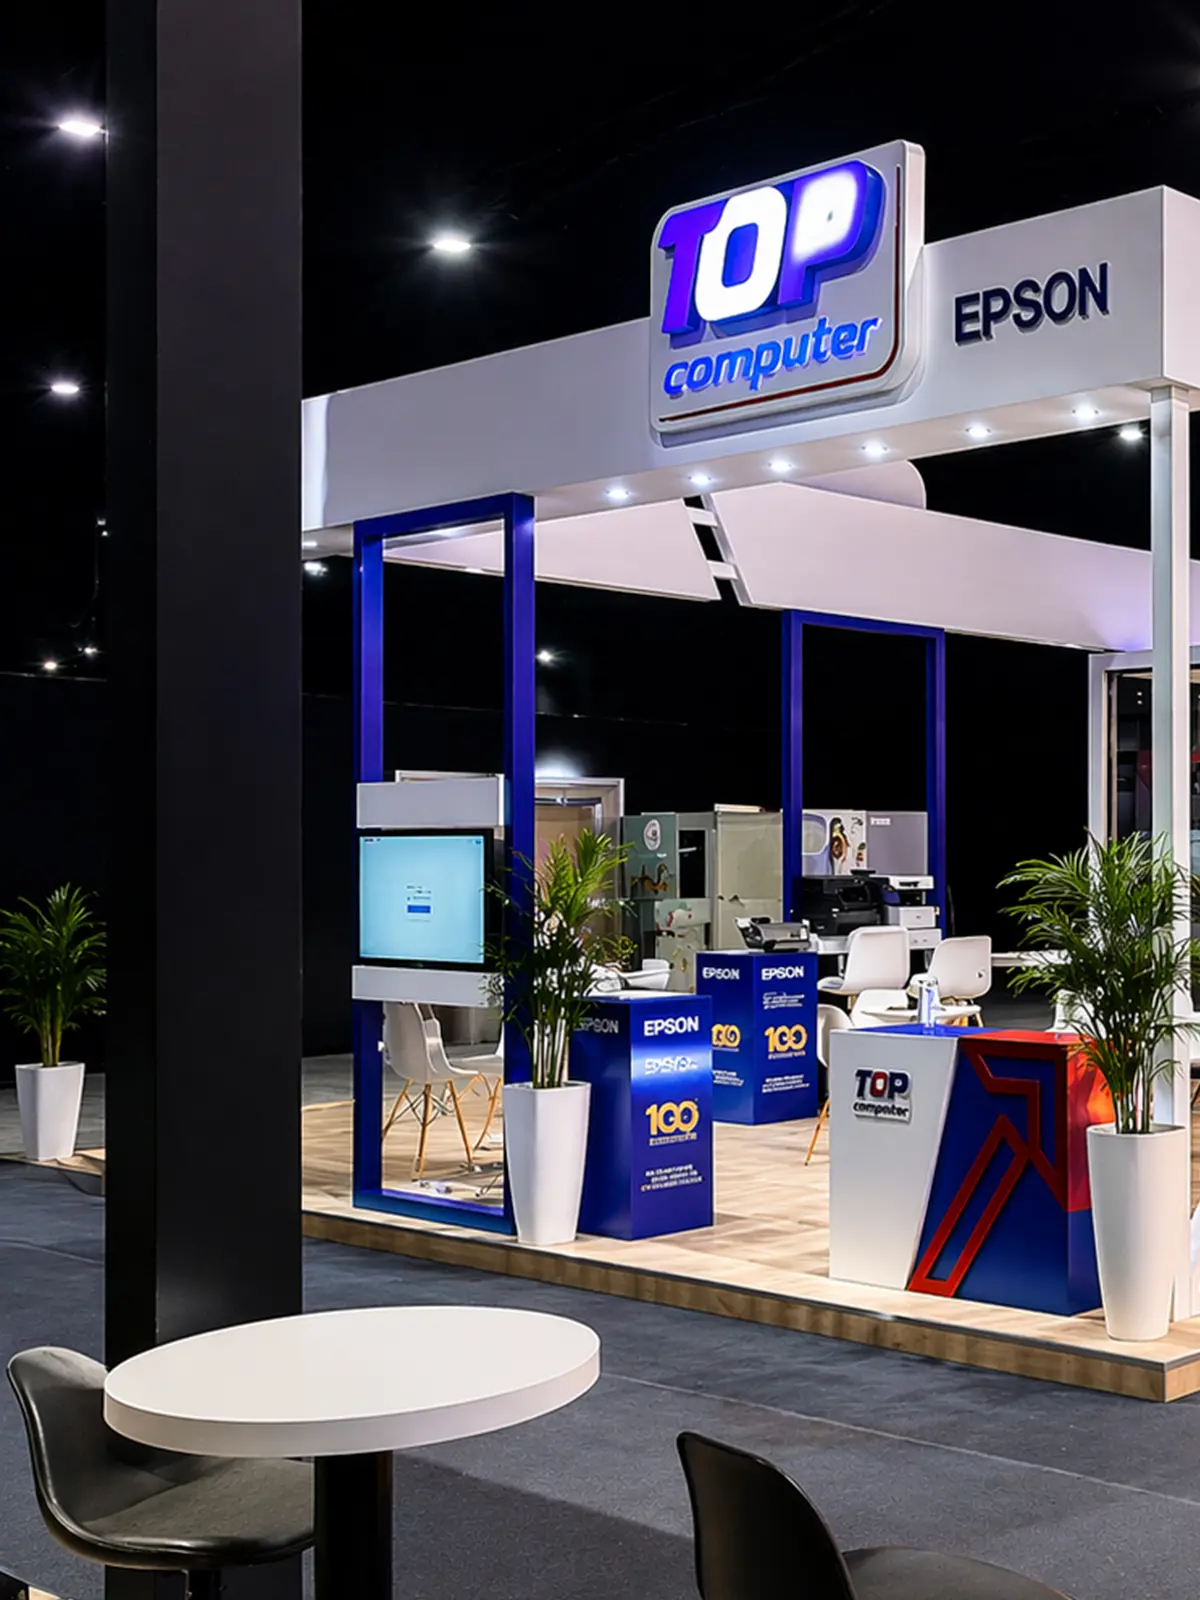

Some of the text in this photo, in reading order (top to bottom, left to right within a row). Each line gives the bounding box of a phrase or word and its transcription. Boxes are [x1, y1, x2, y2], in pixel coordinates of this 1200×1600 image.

[658, 160, 883, 338] TOP
[954, 262, 1110, 346] EPSON
[664, 317, 882, 396] computer
[702, 967, 740, 980] EPSON
[761, 966, 805, 981] EPSON
[643, 1016, 699, 1037] EPSON
[764, 1024, 808, 1053] 100
[855, 1068, 910, 1100] TOP
[645, 1100, 699, 1136] 100
